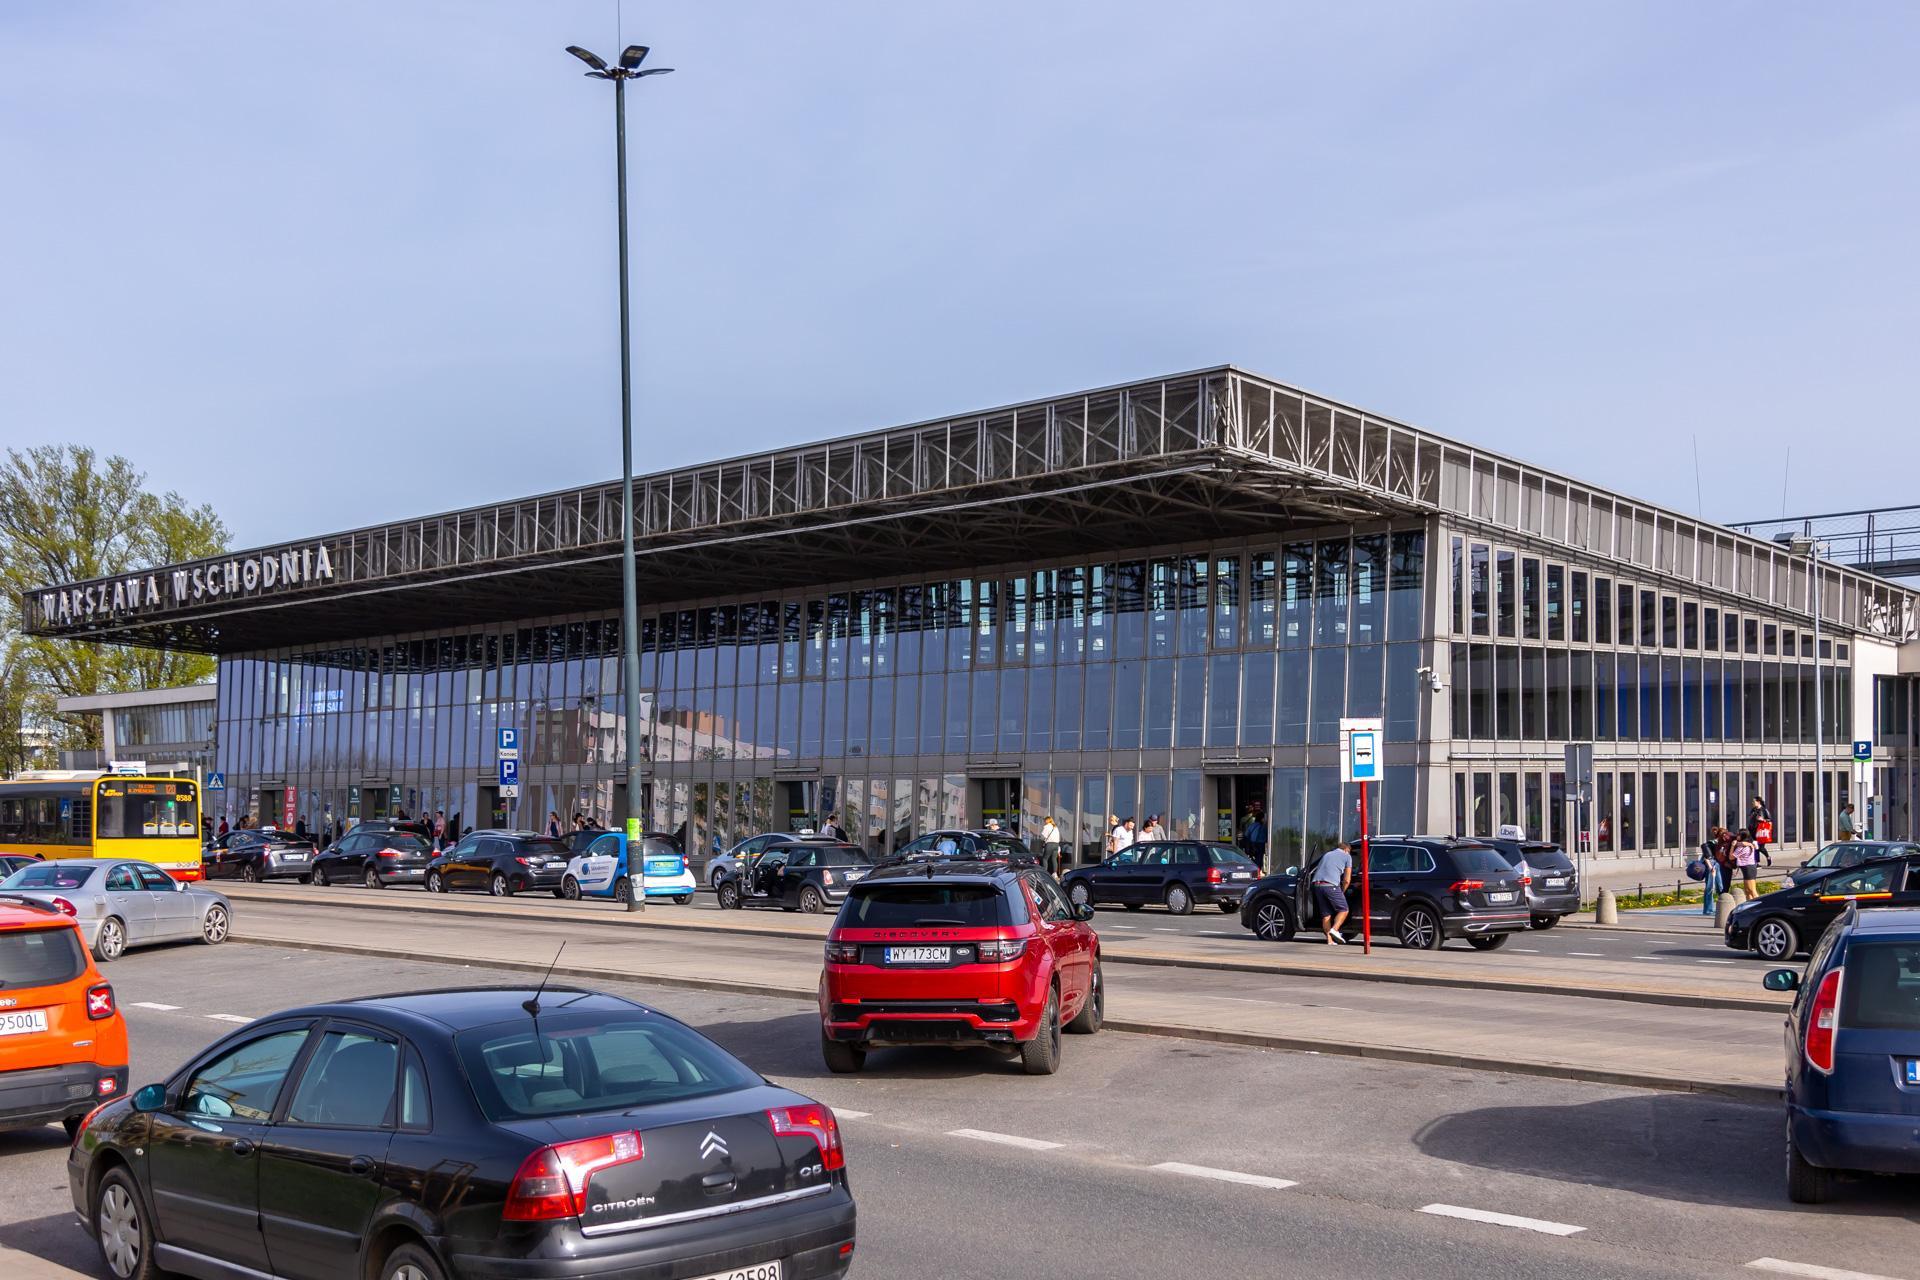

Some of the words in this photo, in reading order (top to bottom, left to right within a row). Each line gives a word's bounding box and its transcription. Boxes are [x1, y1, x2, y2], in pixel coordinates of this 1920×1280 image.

[42, 576, 160, 621] WARSZAWA
[173, 546, 333, 601] WSCHODNIA
[503, 730, 514, 746] P
[1859, 744, 1867, 753] P
[503, 761, 514, 777] P
[893, 948, 907, 959] WY
[913, 948, 947, 959] 173CM
[0, 1014, 42, 1030] 9500L
[800, 1163, 823, 1177] C5
[592, 1196, 655, 1212] CITROËN
